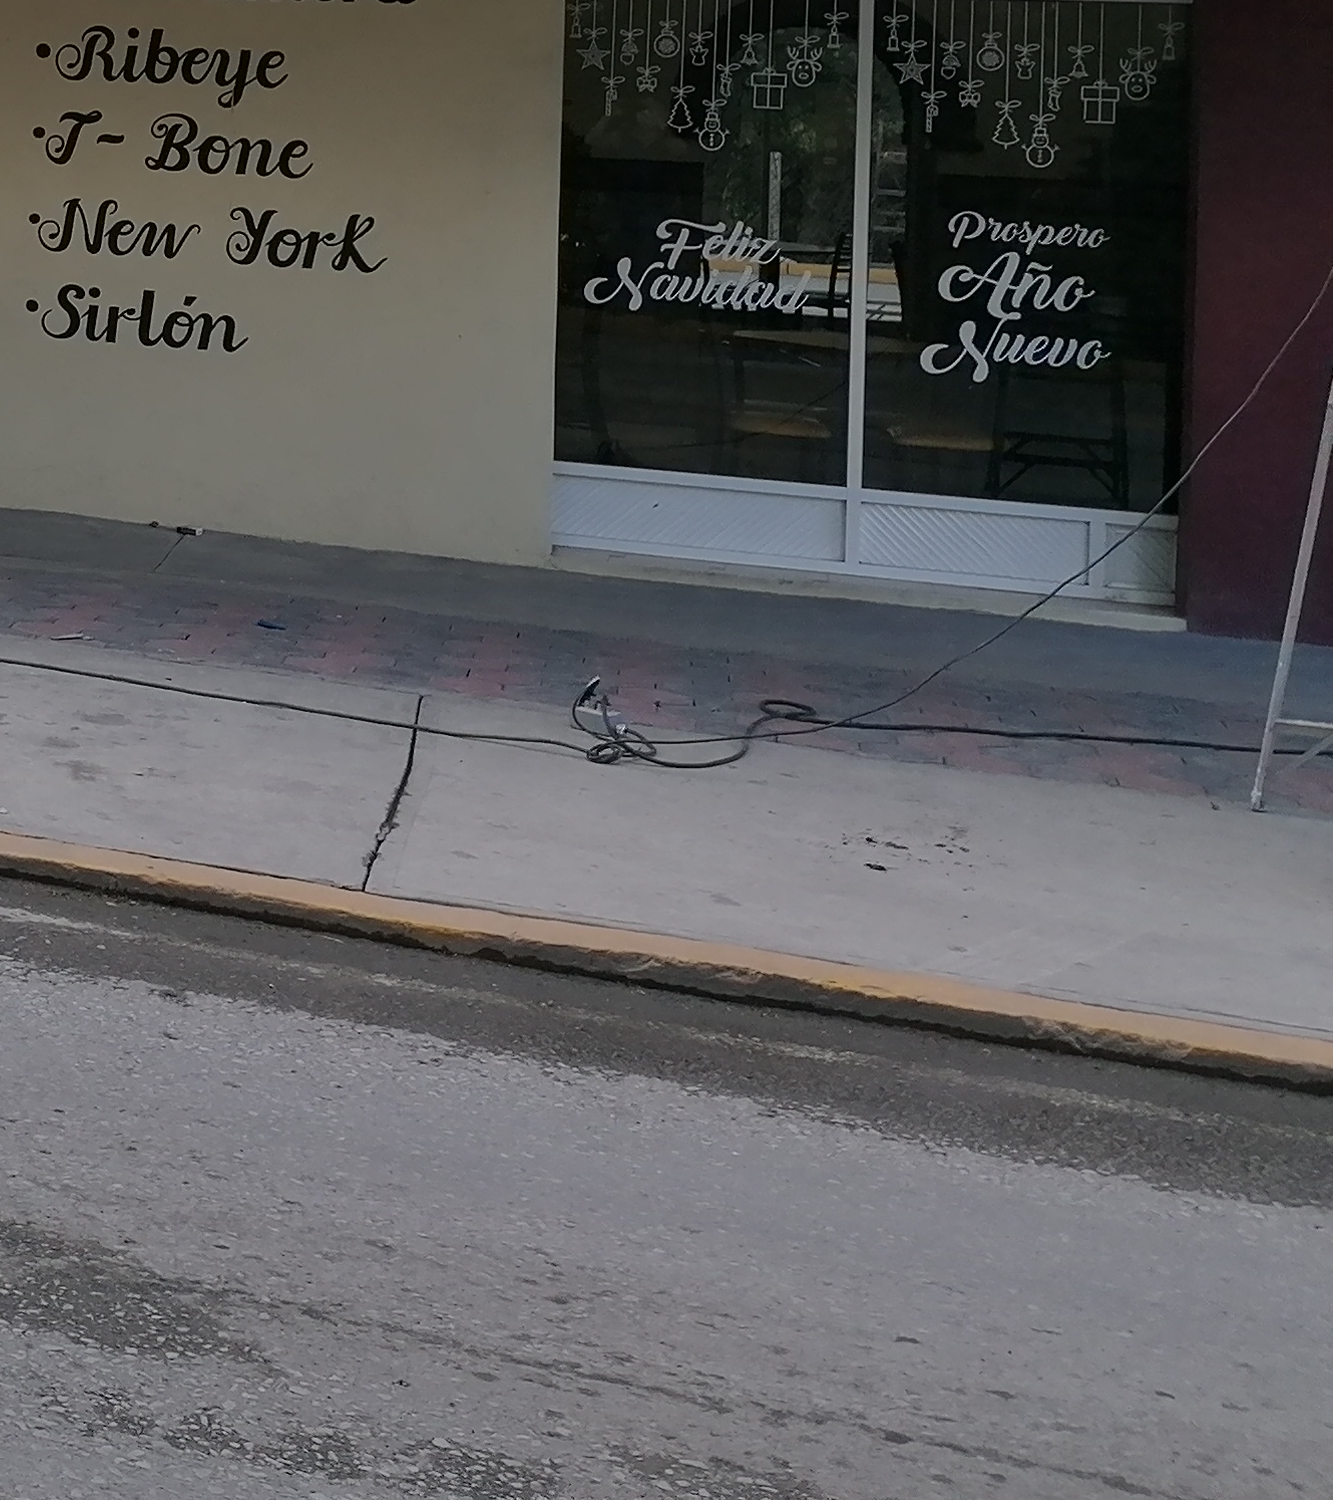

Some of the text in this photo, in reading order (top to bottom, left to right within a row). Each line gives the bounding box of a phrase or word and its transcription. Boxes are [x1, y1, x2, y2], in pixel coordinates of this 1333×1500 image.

[55, 25, 288, 108] Ribeye
[144, 113, 314, 179] Bone
[37, 198, 388, 273] New York
[656, 218, 785, 270] Feliz
[947, 210, 1112, 254] Prospero
[40, 283, 249, 353] Sirlón
[583, 257, 811, 312] Navidad
[937, 250, 1095, 320] Año
[920, 312, 1112, 383] Nuevo
